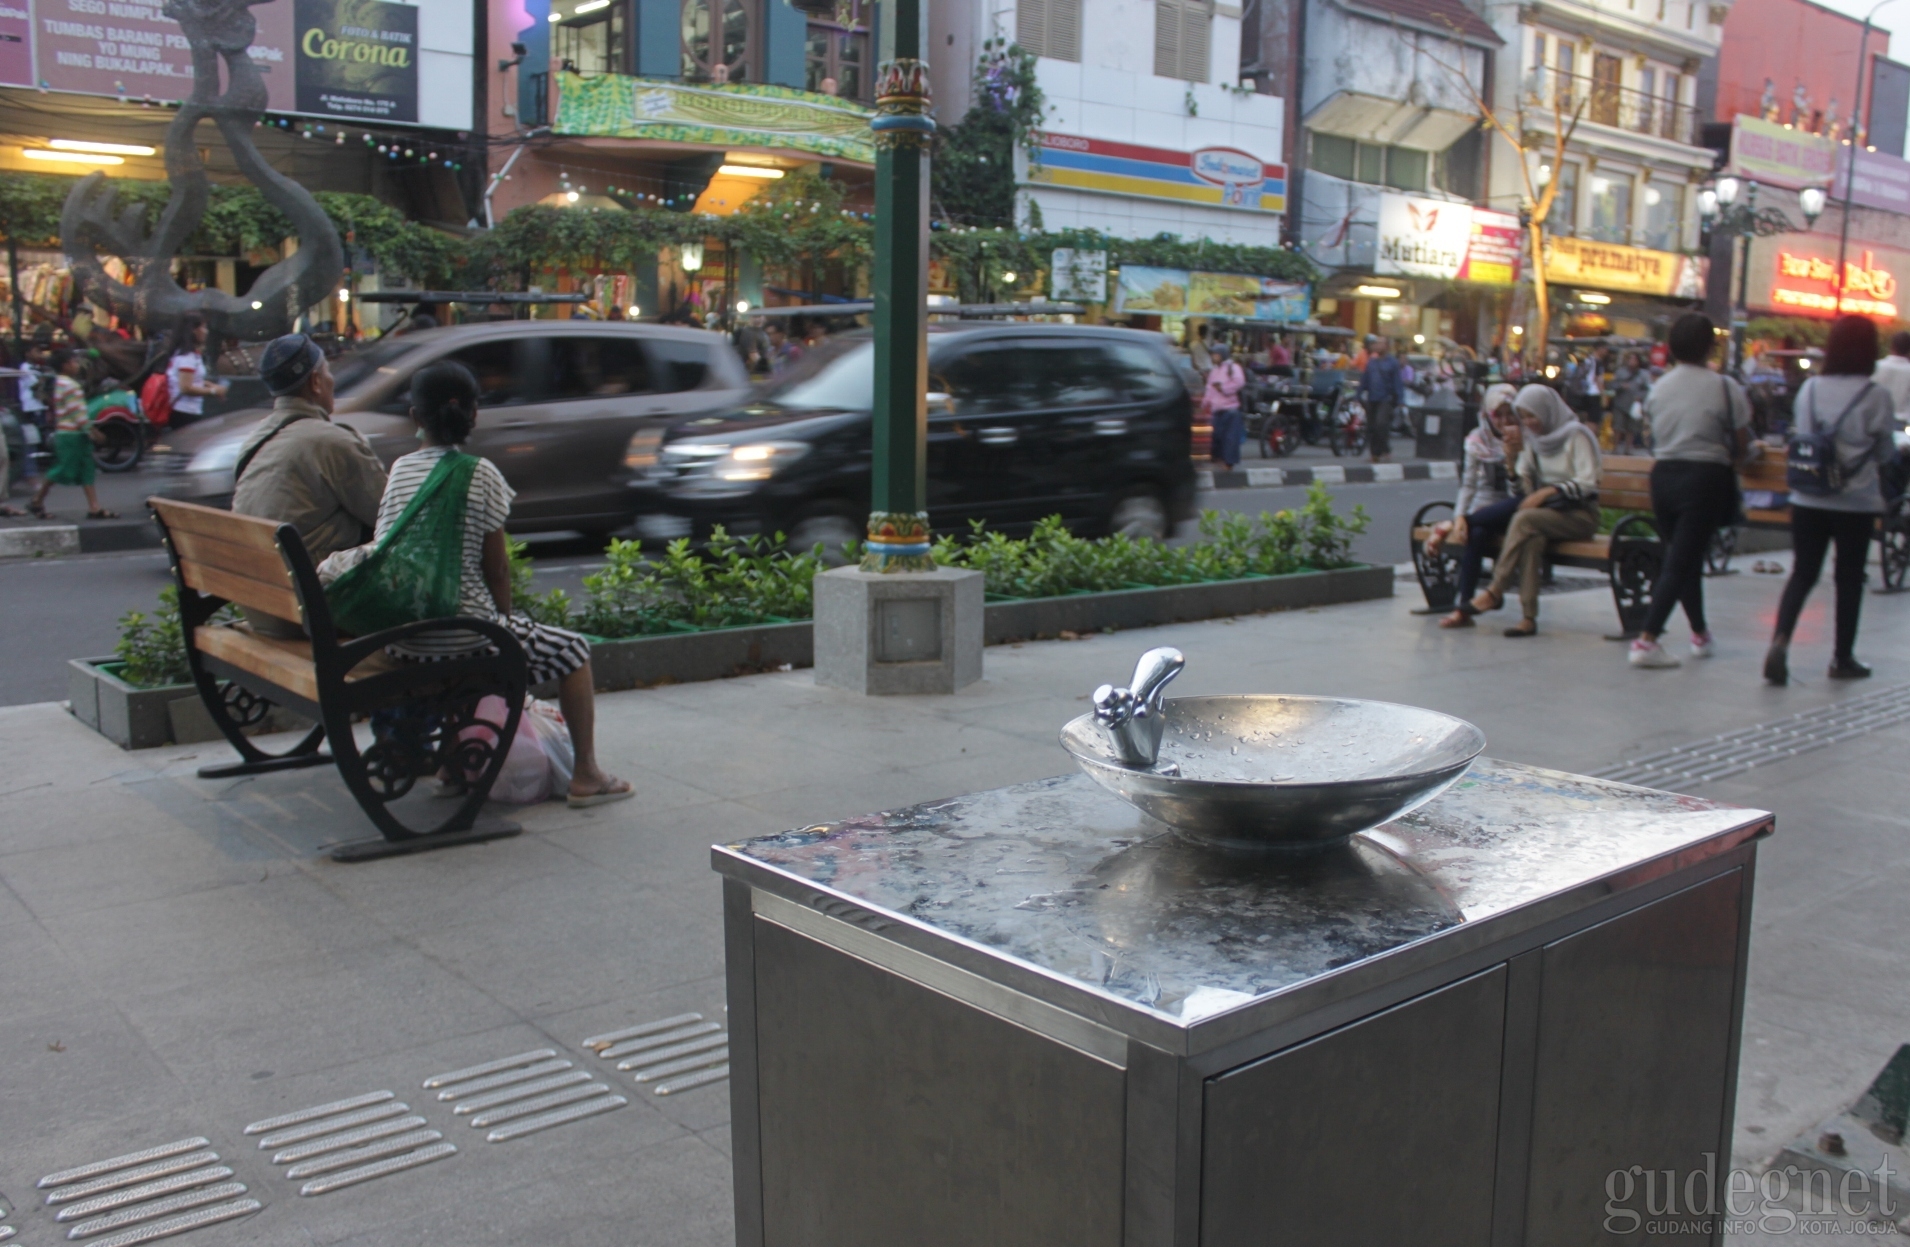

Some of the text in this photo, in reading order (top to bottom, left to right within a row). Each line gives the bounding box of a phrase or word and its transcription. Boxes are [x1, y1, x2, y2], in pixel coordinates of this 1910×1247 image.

[68, 0, 106, 14] SEGO
[44, 19, 105, 40] TUMBAS
[107, 27, 163, 47] BARANG
[380, 30, 412, 43] BATIK
[97, 41, 161, 61] YO MUNG
[302, 27, 411, 68] Corona
[57, 51, 92, 68] NING
[1381, 236, 1459, 268] Mutiara
